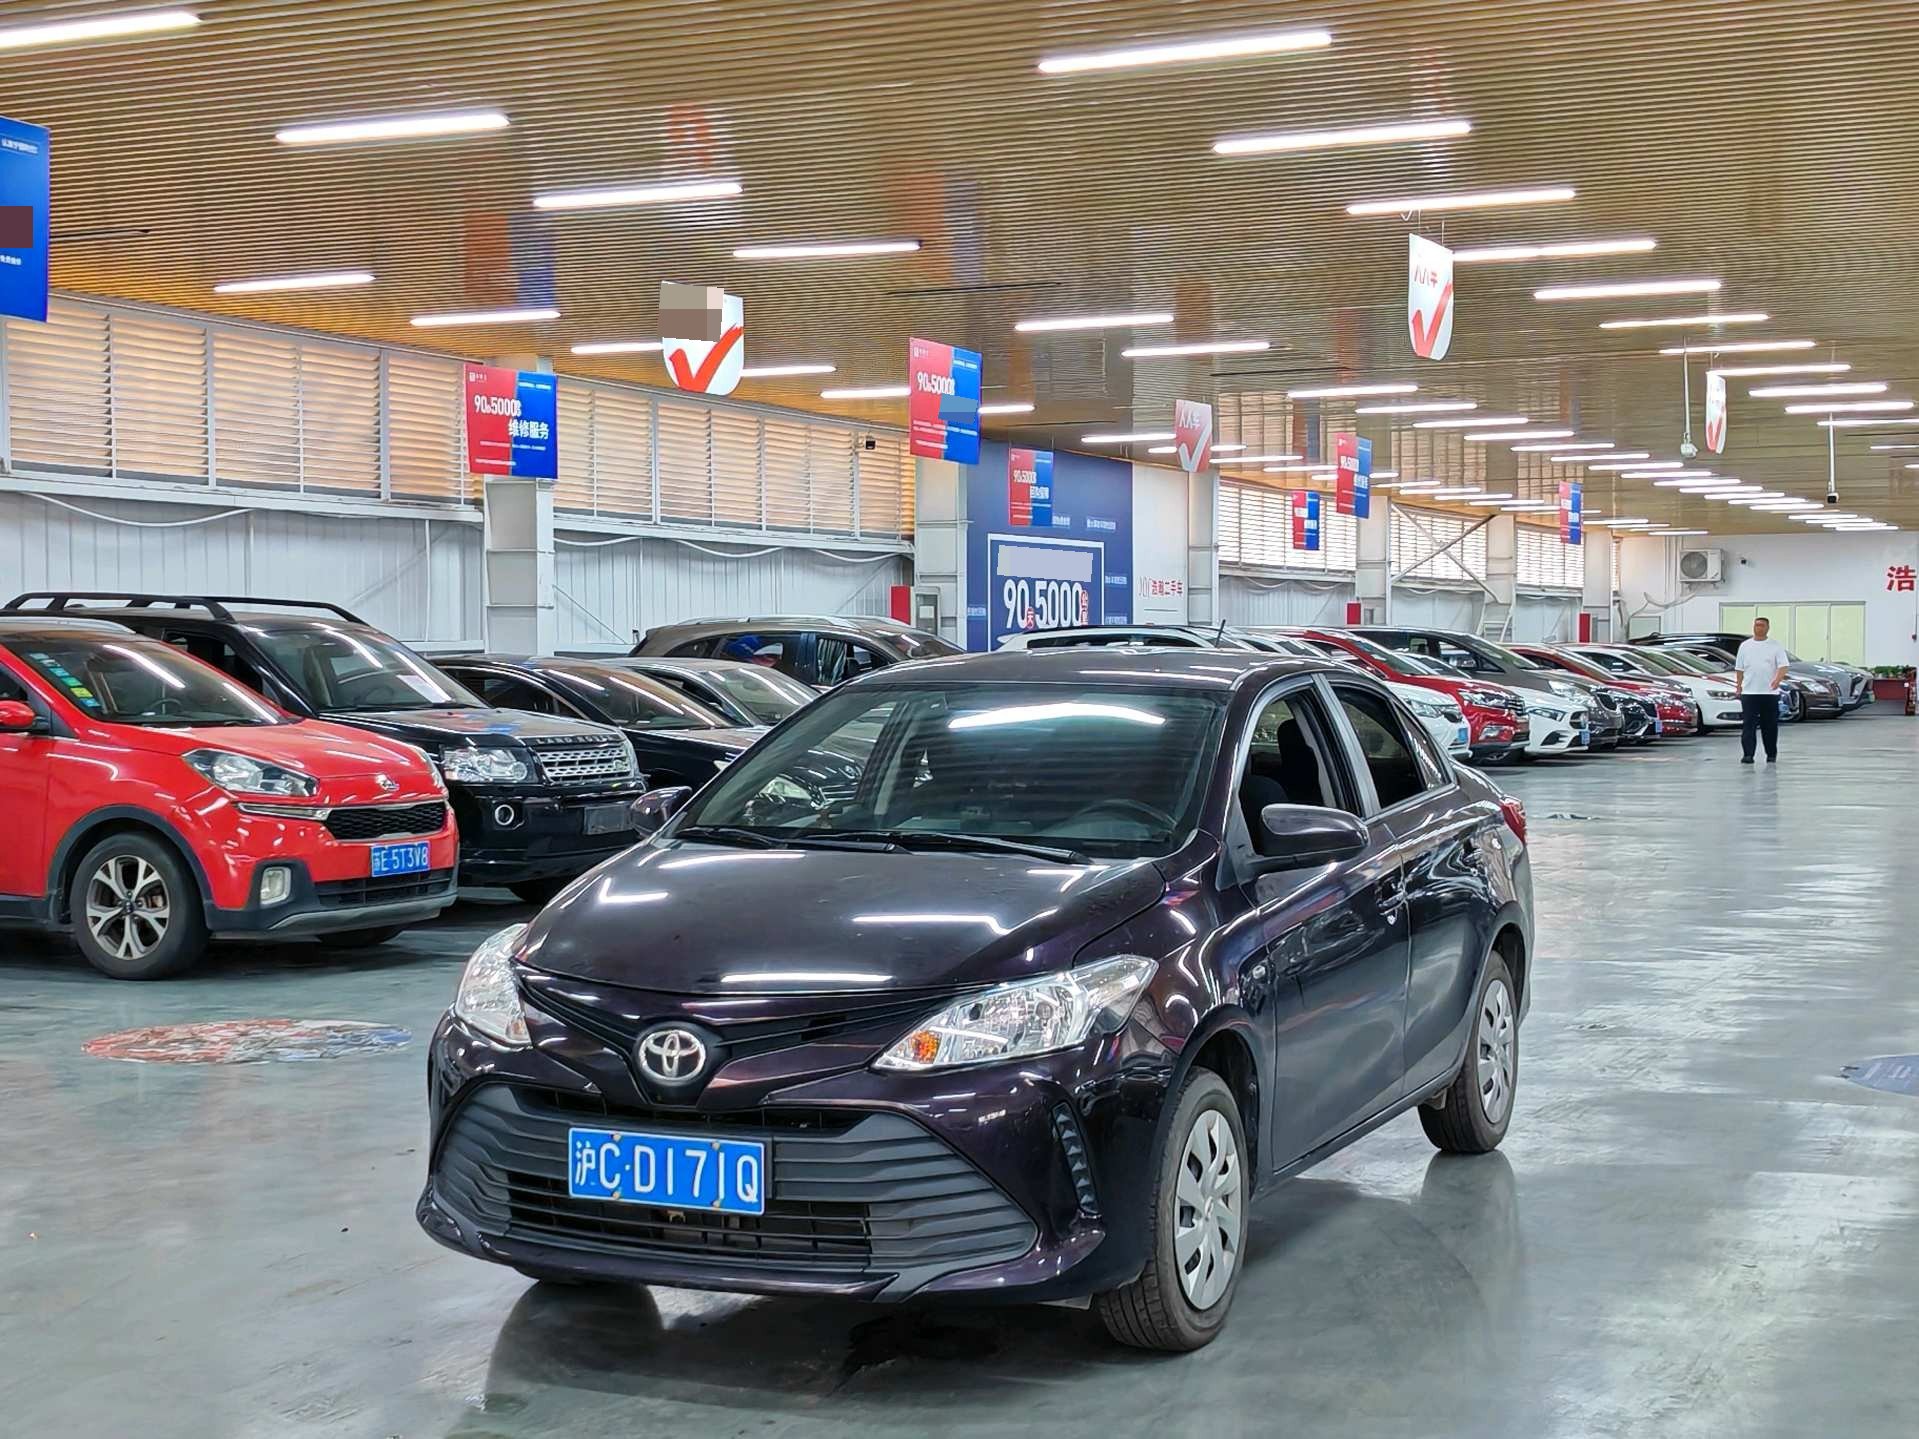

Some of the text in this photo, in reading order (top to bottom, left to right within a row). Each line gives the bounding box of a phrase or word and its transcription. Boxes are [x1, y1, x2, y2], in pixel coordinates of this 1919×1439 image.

[508, 418, 549, 440] 维修服务
[1886, 564, 1917, 592] 浩
[536, 737, 573, 745] LAND
